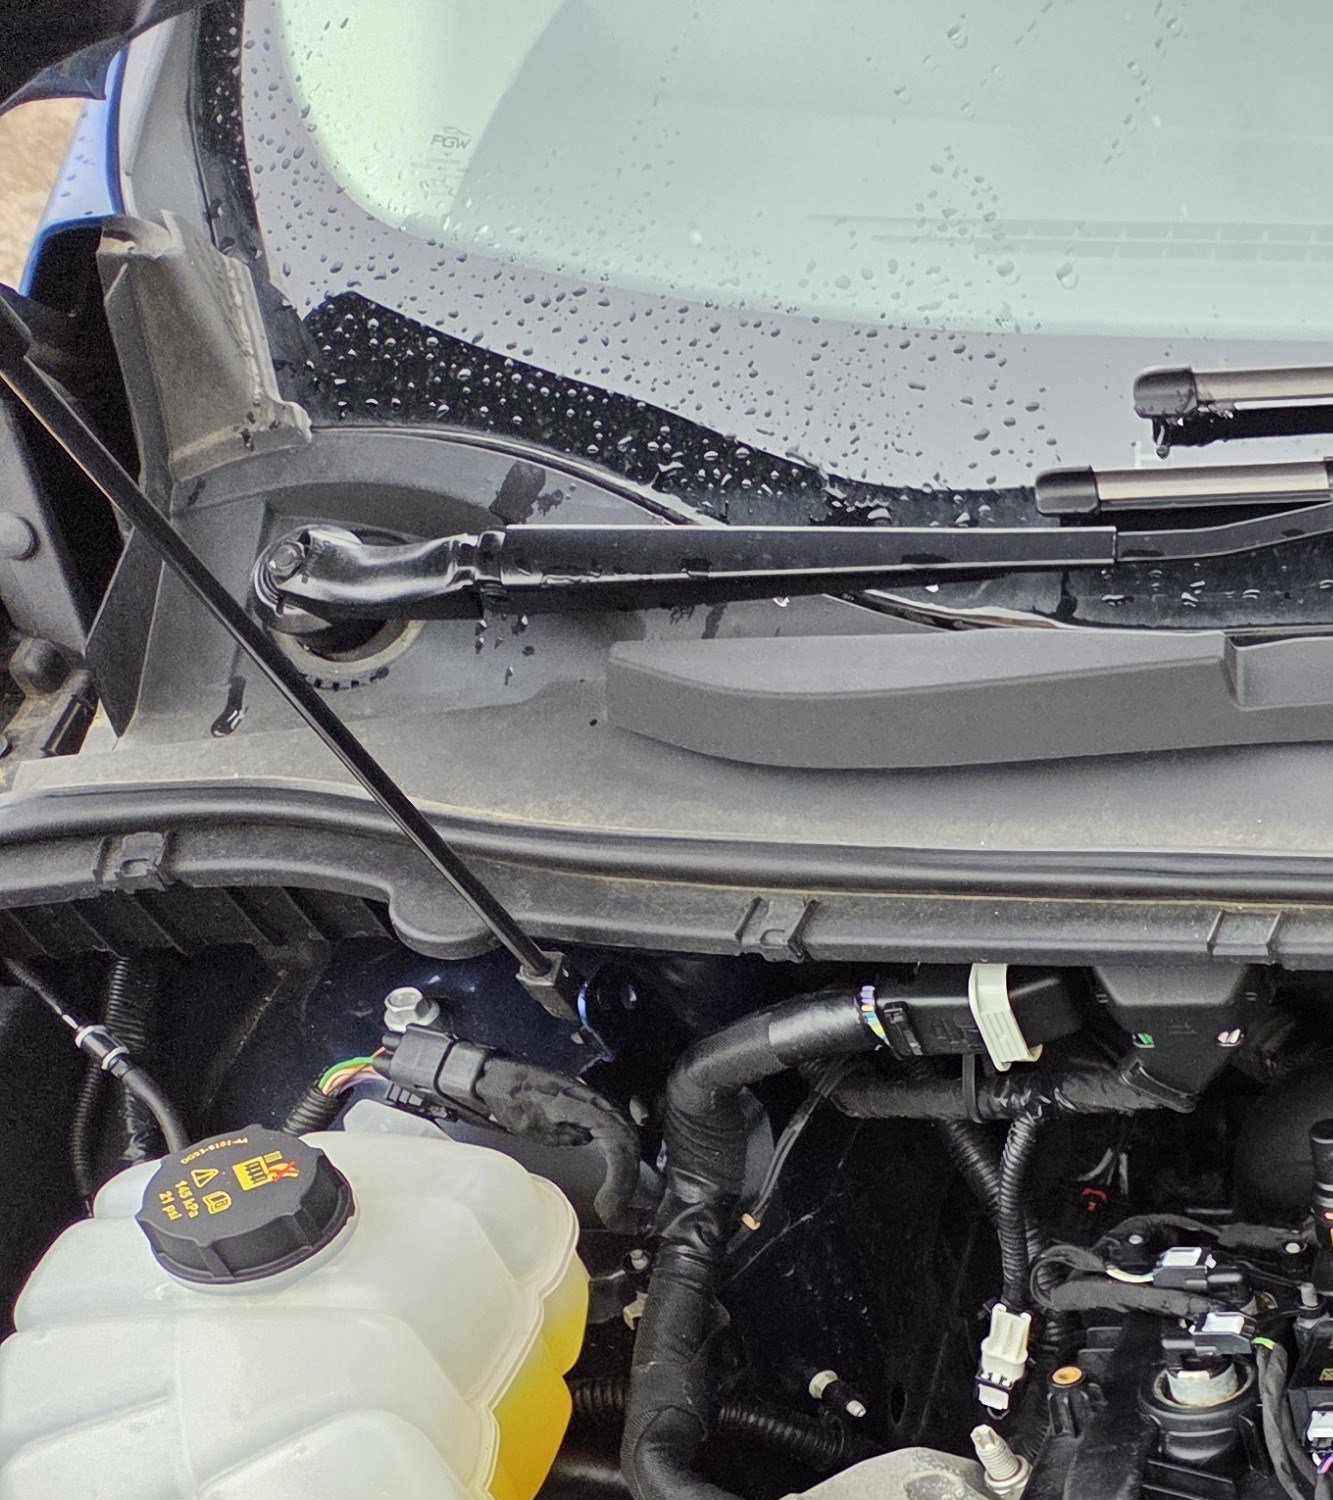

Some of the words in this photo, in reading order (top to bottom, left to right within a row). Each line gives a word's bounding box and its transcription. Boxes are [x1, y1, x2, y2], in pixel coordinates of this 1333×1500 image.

[159, 1191, 175, 1204] 21
[175, 1180, 192, 1200] 145
[184, 1198, 199, 1218] kPa
[162, 1204, 183, 1220] psi
